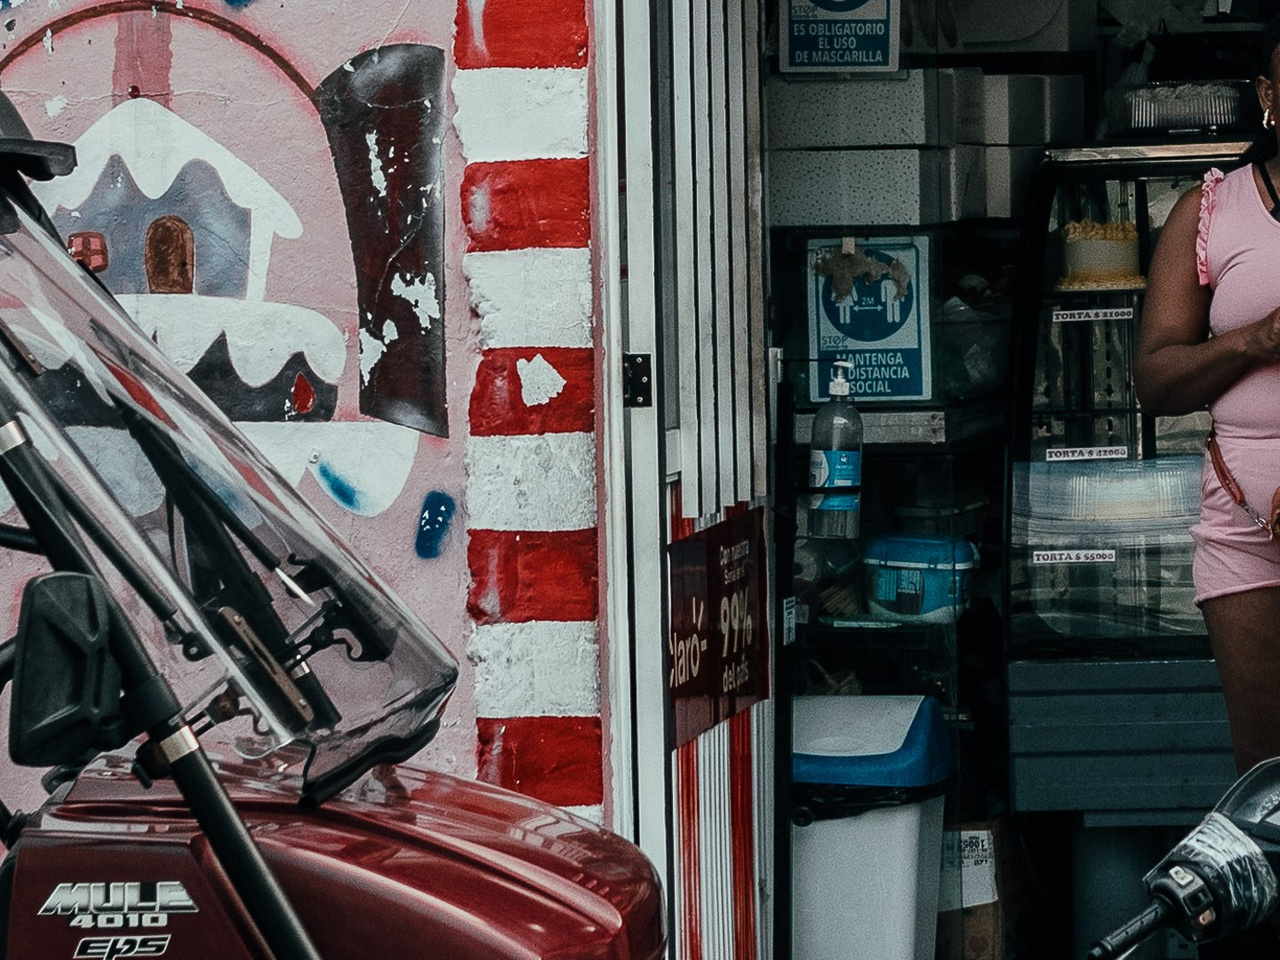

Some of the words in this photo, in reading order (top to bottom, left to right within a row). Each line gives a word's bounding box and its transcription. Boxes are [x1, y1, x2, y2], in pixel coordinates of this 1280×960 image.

[793, 23, 806, 35] ES
[809, 23, 885, 35] OBLIGATORIO
[818, 37, 830, 49] EL
[833, 37, 857, 49] USO
[795, 51, 809, 63] DE
[812, 50, 883, 63] MASCARILLA
[862, 297, 875, 305] 2M
[1054, 312, 1091, 320] TORTA
[1094, 311, 1100, 319] $
[848, 366, 910, 380] DISTANCIA
[850, 380, 891, 394] SOCIAL
[1048, 450, 1085, 458] TORTA
[1035, 553, 1072, 561] TORTA
[720, 586, 753, 658] 99%
[37, 881, 199, 916] MULE
[69, 913, 168, 929] 4010
[72, 934, 172, 960] EPS
